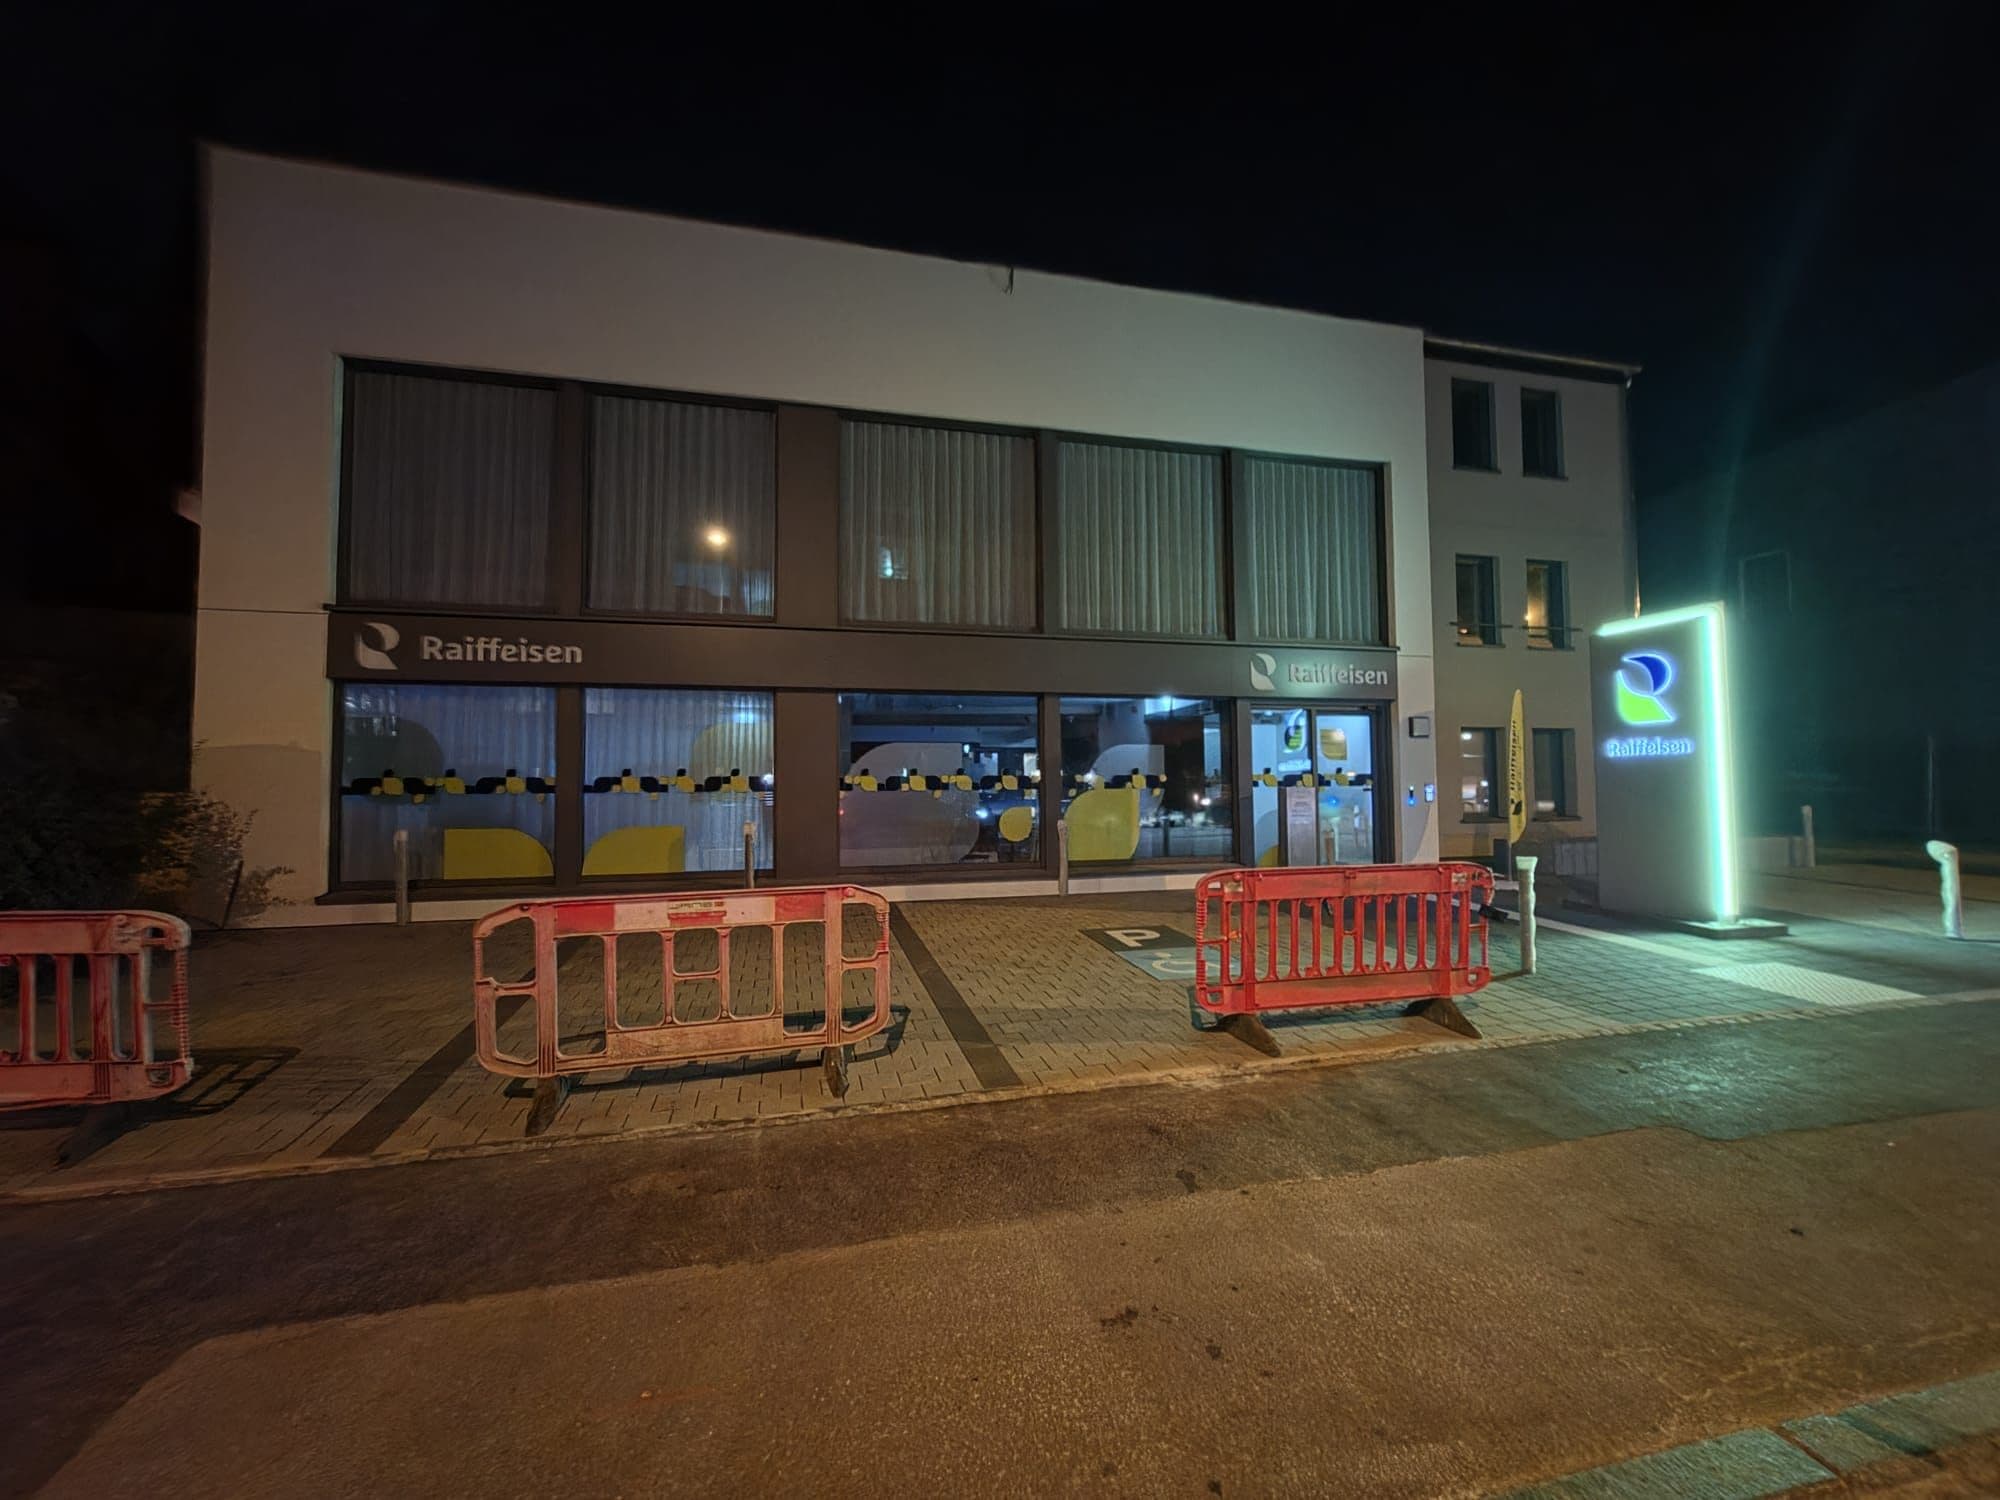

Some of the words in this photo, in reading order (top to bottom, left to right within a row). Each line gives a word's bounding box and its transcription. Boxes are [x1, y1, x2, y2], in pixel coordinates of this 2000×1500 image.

[421, 635, 583, 663] Raiffeisen
[1288, 663, 1388, 685] Raiffeisen
[1606, 736, 1693, 758] Raiffeisen
[1104, 929, 1161, 947] P
